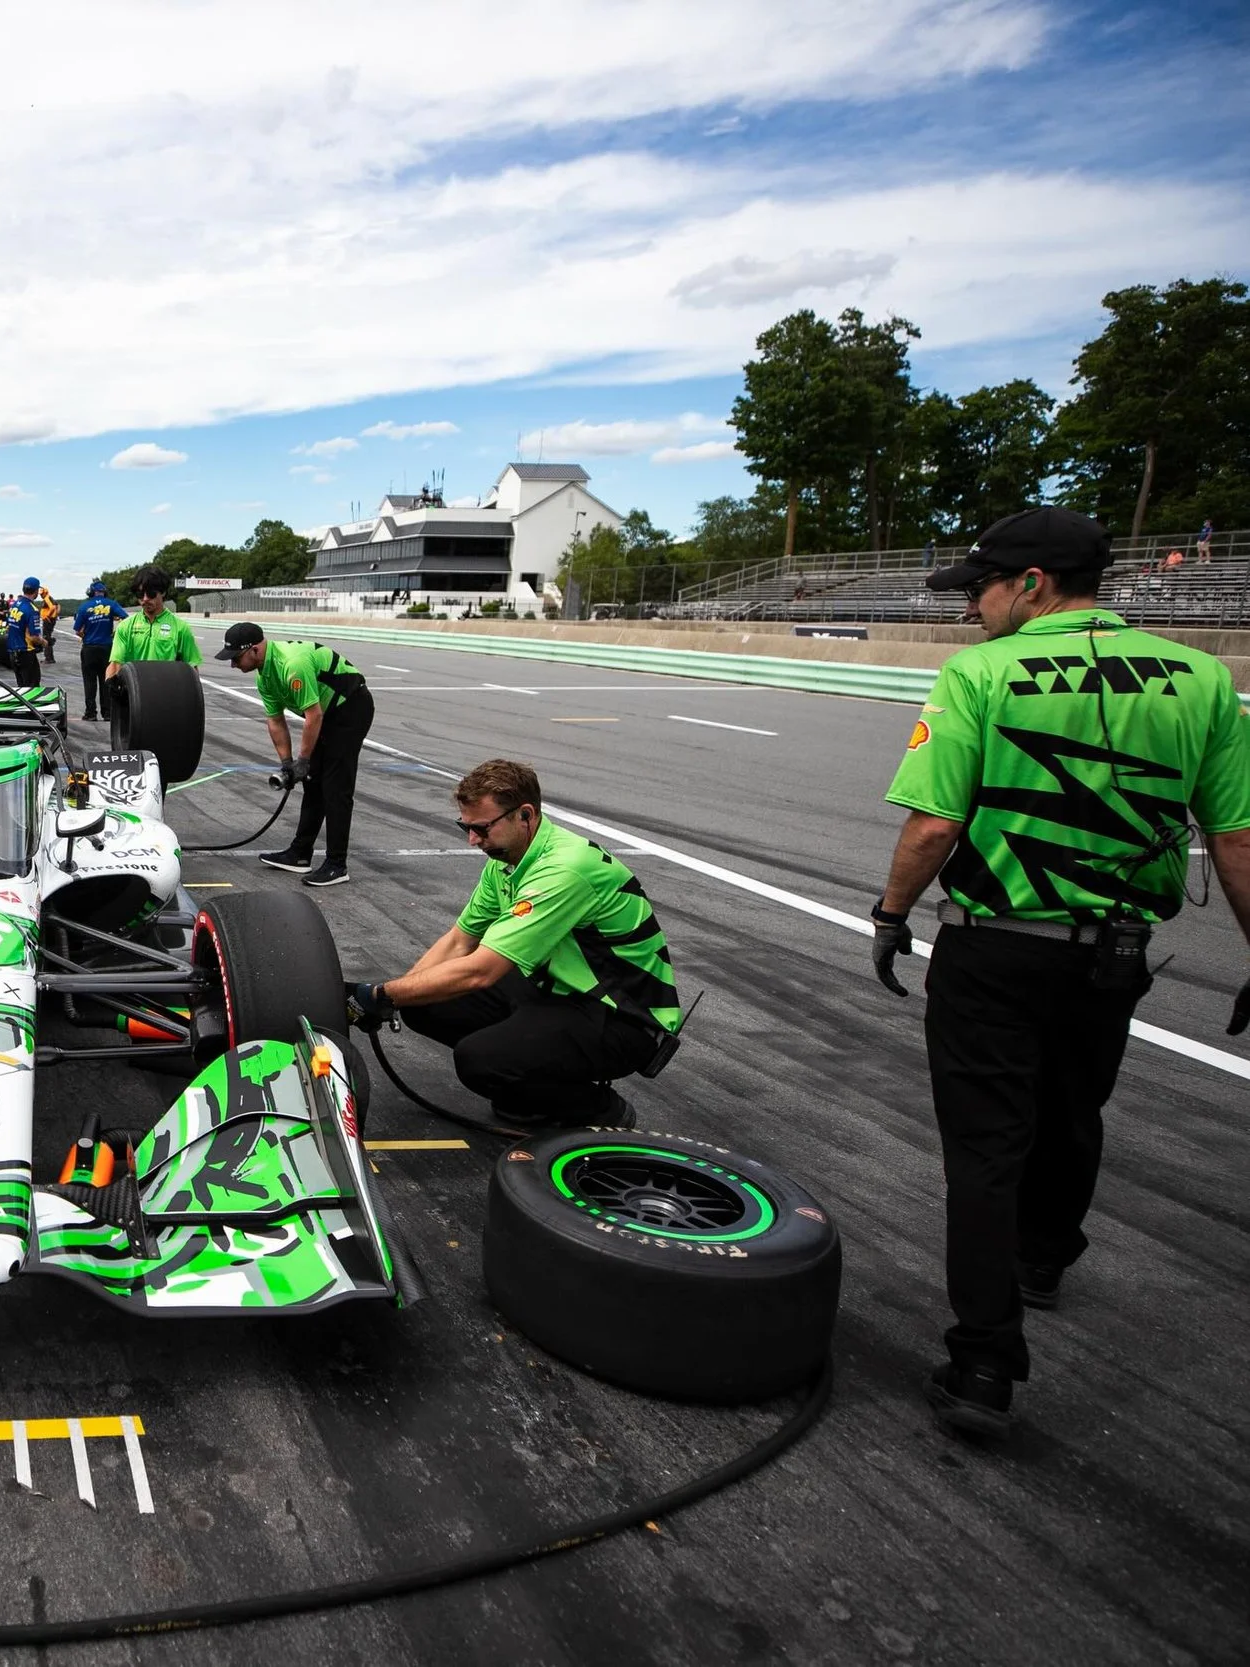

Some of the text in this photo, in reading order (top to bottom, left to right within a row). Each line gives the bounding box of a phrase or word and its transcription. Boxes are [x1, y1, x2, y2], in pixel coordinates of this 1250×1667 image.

[261, 588, 328, 598] WeatherTech
[92, 754, 139, 764] AIPEX
[111, 846, 162, 859] DCM
[79, 862, 159, 873] Firestone
